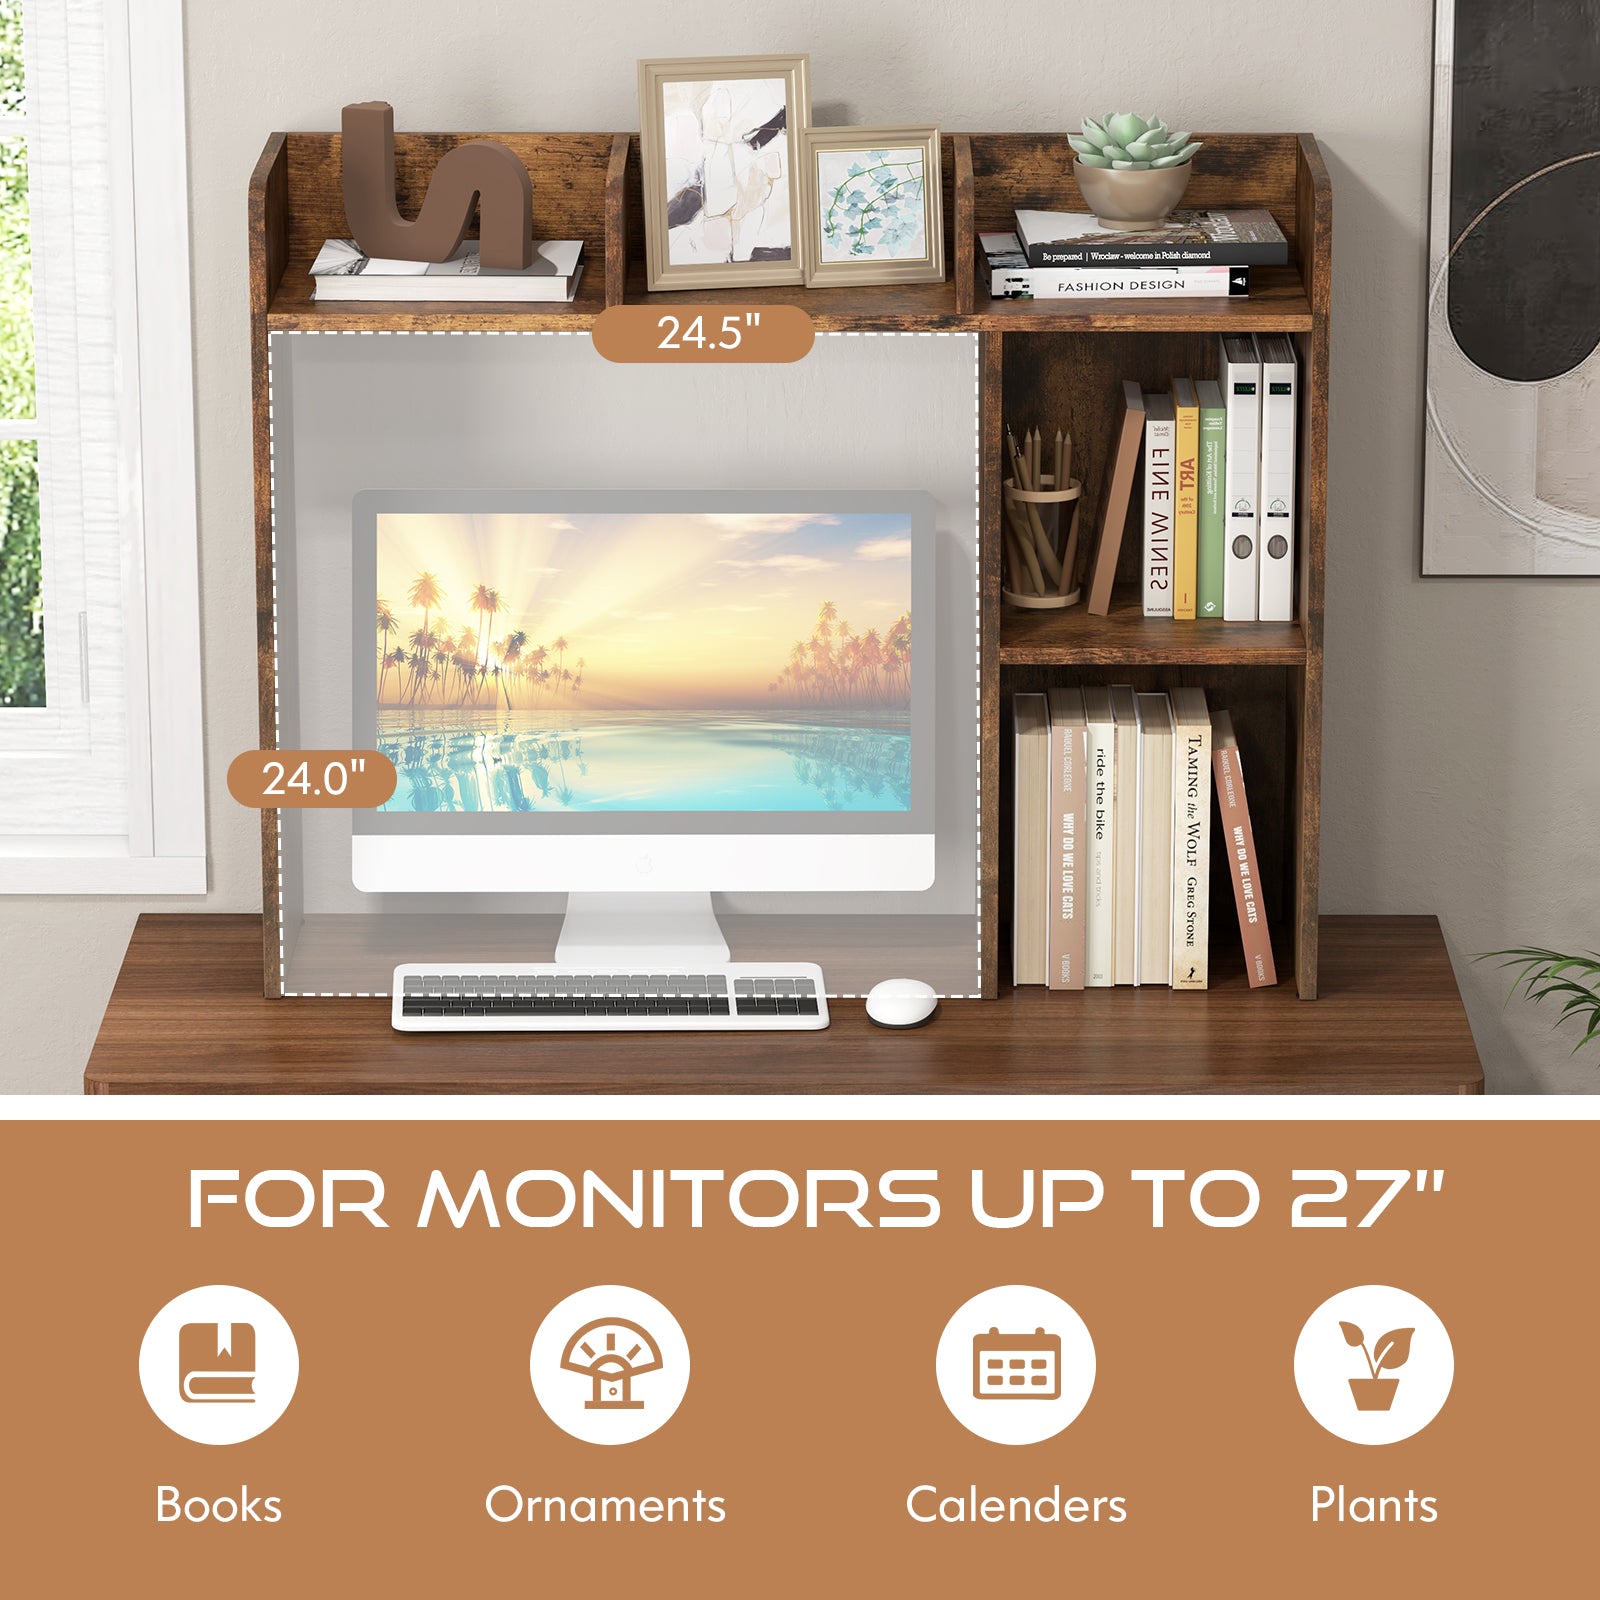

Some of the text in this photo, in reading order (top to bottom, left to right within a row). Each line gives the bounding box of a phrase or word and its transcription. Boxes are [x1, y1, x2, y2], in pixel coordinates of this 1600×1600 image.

[1042, 253, 1052, 261] Be
[1052, 253, 1083, 262] prepared
[1124, 252, 1153, 260] welcome
[1154, 251, 1161, 260] in
[1162, 251, 1181, 260] Polish
[1181, 251, 1211, 260] diamond
[1058, 281, 1124, 292] FASHION
[1130, 280, 1185, 290] DESIGN
[1064, 728, 1073, 755] RAQUEL
[1095, 748, 1106, 841] ride the bike
[1186, 734, 1202, 867] TAMING the WOLF
[1062, 813, 1075, 920] WHY DO WE LOVE CATS
[1233, 826, 1258, 924] WHY DO WE LOVE CATS
[1186, 876, 1198, 948] GREG STONE
